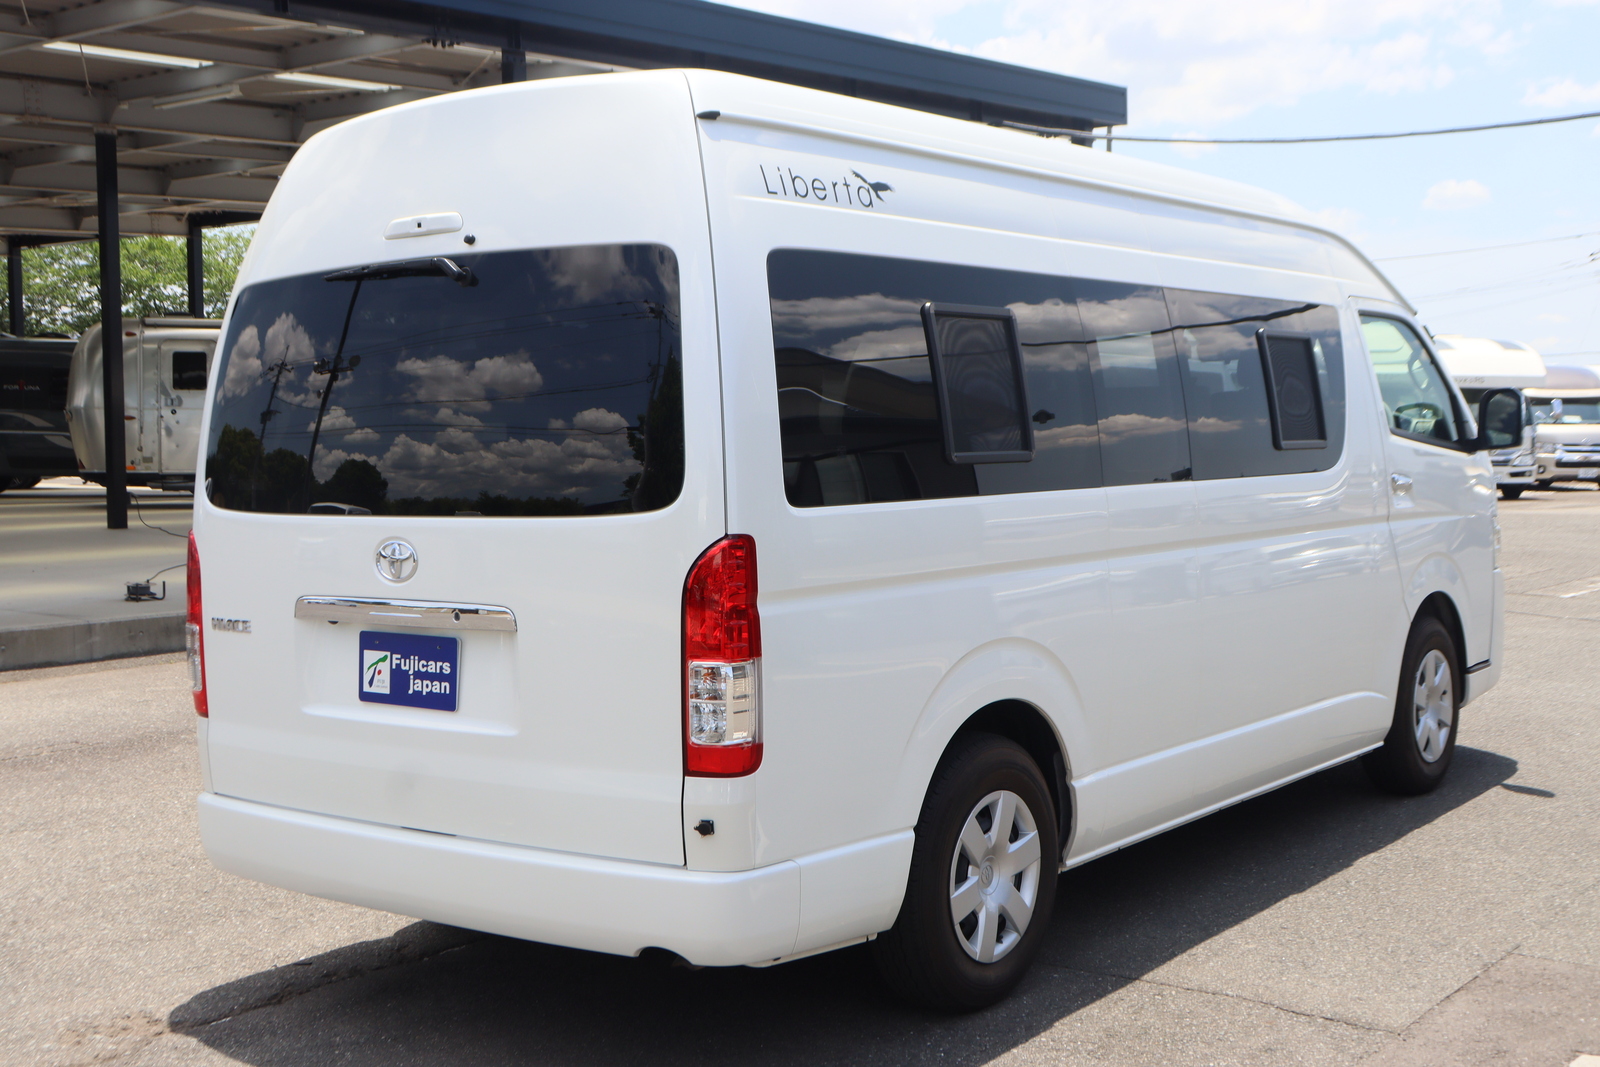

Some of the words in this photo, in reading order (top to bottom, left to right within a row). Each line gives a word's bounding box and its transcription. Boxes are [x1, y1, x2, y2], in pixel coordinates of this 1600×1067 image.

[759, 164, 874, 208] Liberta
[392, 653, 451, 675] Fujicars
[408, 675, 450, 696] japan
